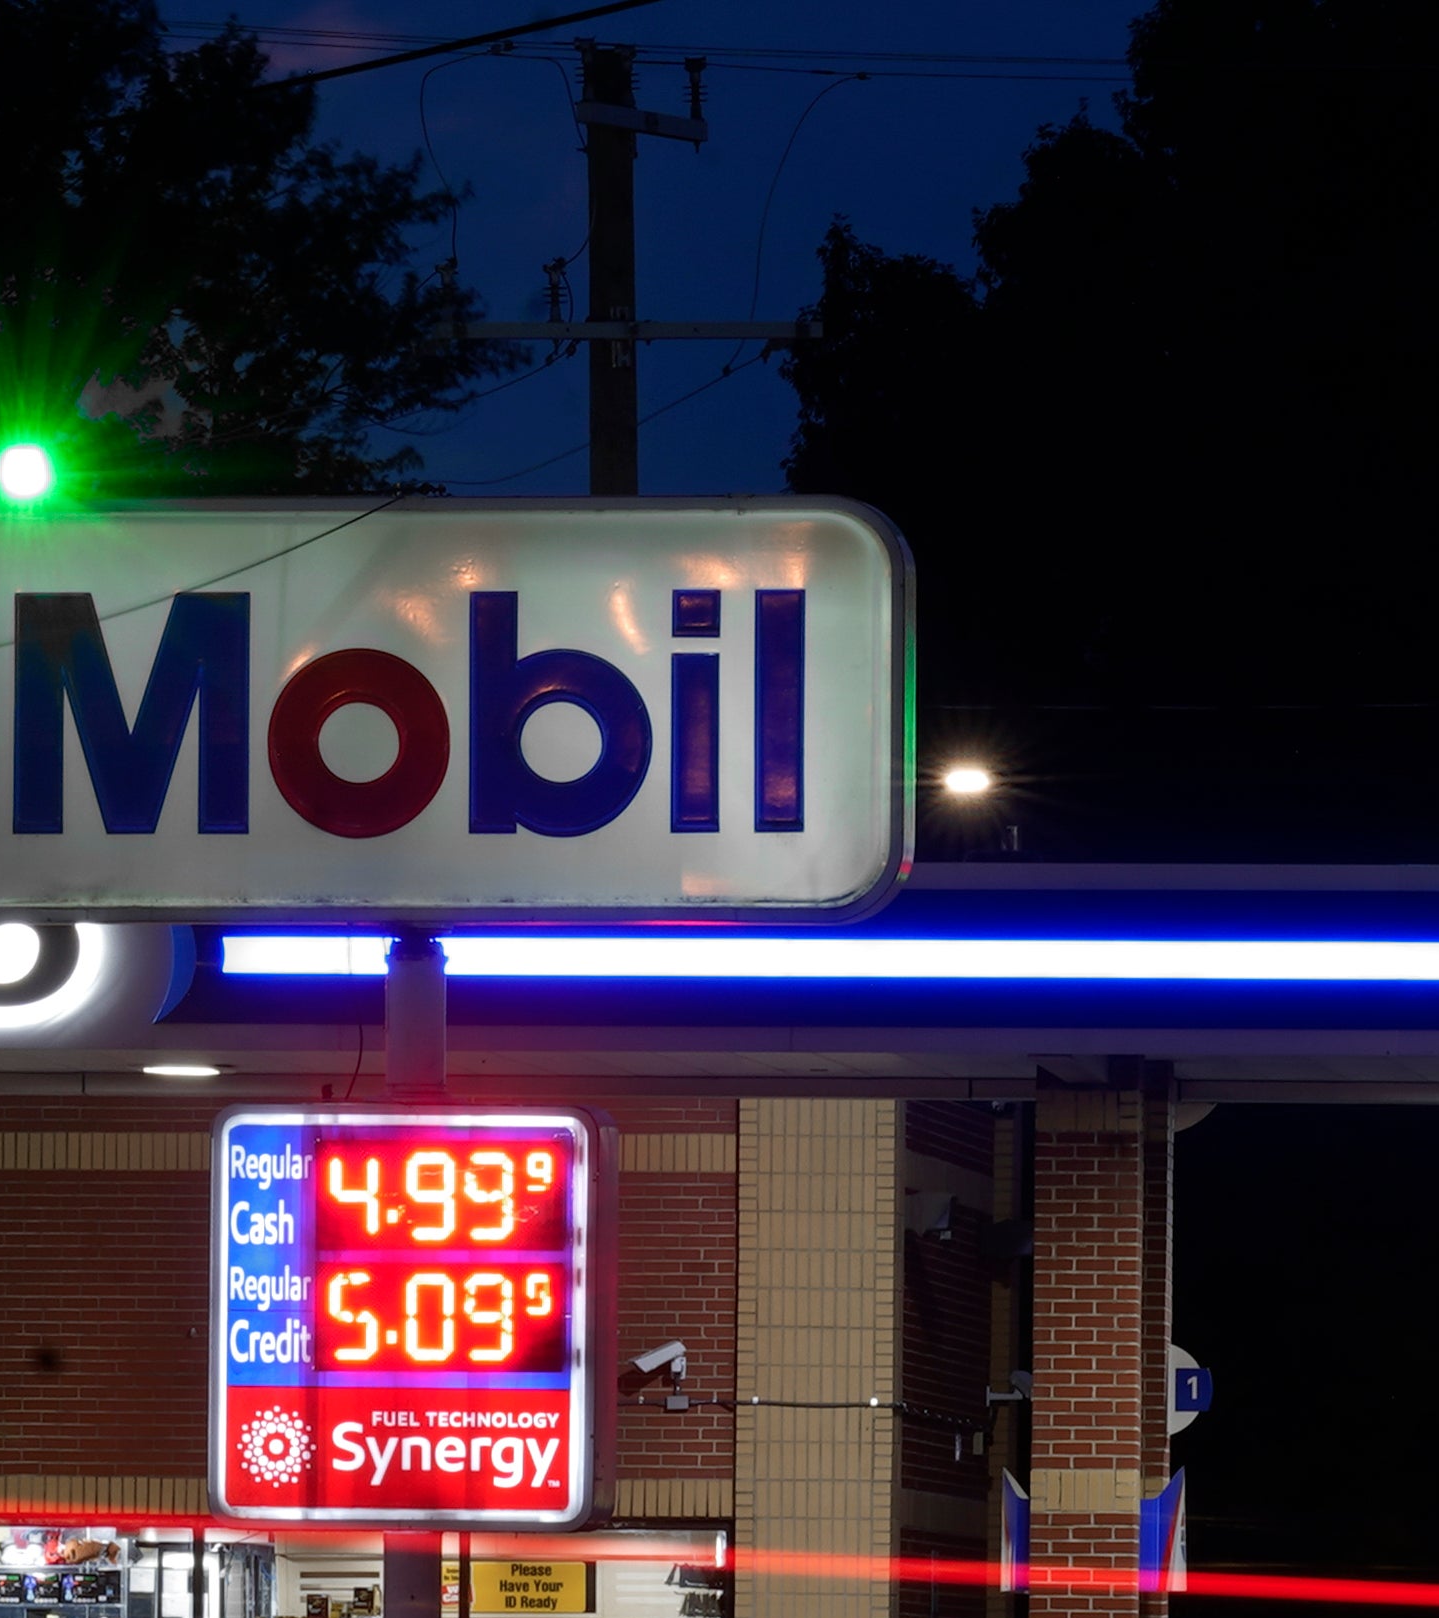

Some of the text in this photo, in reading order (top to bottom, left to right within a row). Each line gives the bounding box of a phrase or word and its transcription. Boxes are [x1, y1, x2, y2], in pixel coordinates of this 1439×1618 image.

[12, 589, 806, 838] Mobil
[231, 1144, 312, 1190] Regular
[231, 1201, 294, 1245] Cash
[230, 1265, 312, 1311] Regular
[230, 1320, 312, 1363] Credit
[1186, 1376, 1199, 1399] 1
[372, 1411, 560, 1428] FUEL TECHNOLOGY
[331, 1421, 560, 1488] Synergy
[500, 1580, 563, 1592] Have Your
[511, 1563, 552, 1576] Please
[505, 1596, 558, 1610] ID Ready
